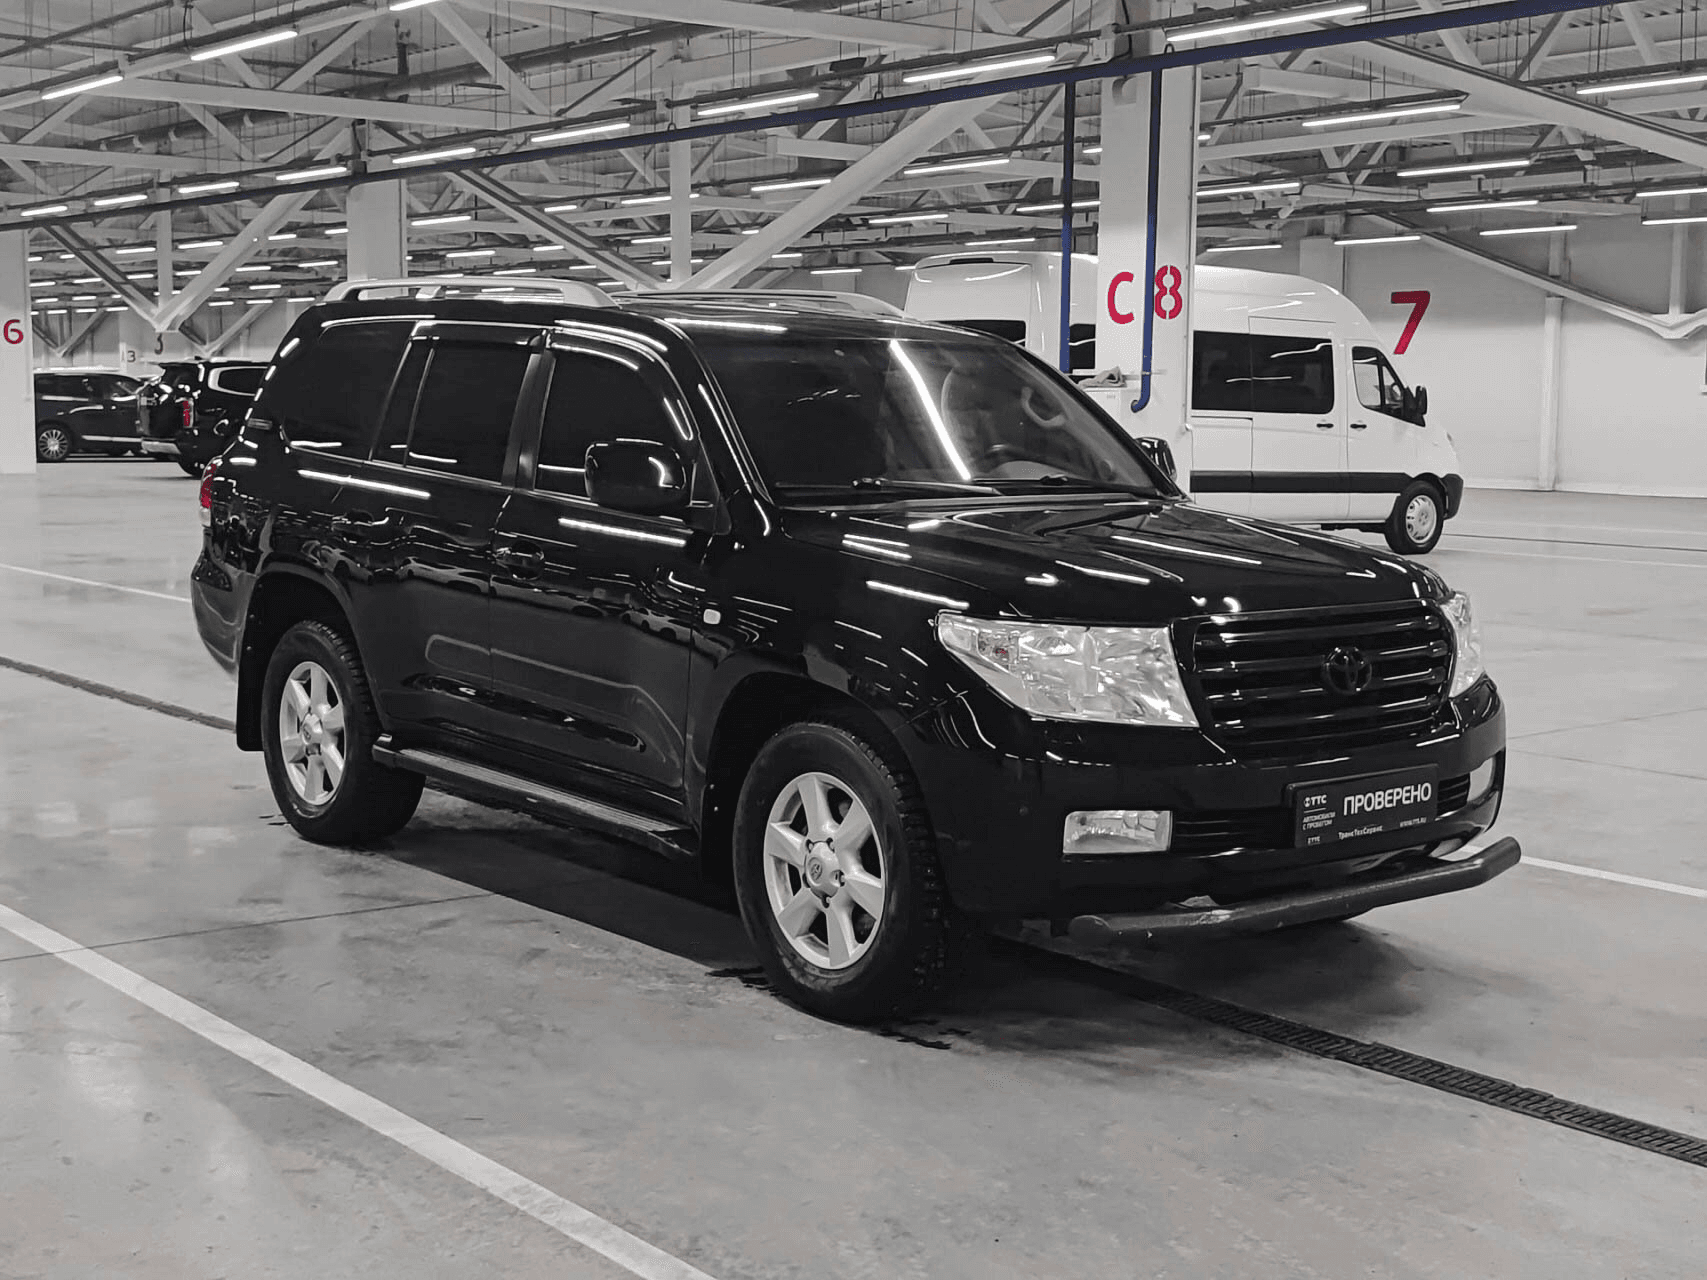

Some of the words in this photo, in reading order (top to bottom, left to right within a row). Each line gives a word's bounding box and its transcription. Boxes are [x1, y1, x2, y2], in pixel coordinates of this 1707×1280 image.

[1154, 265, 1183, 320] 8
[3, 319, 24, 345] 6
[1390, 289, 1431, 355] 7
[126, 350, 137, 363] 3
[1343, 782, 1432, 816] ПРОВЕРЕНО
